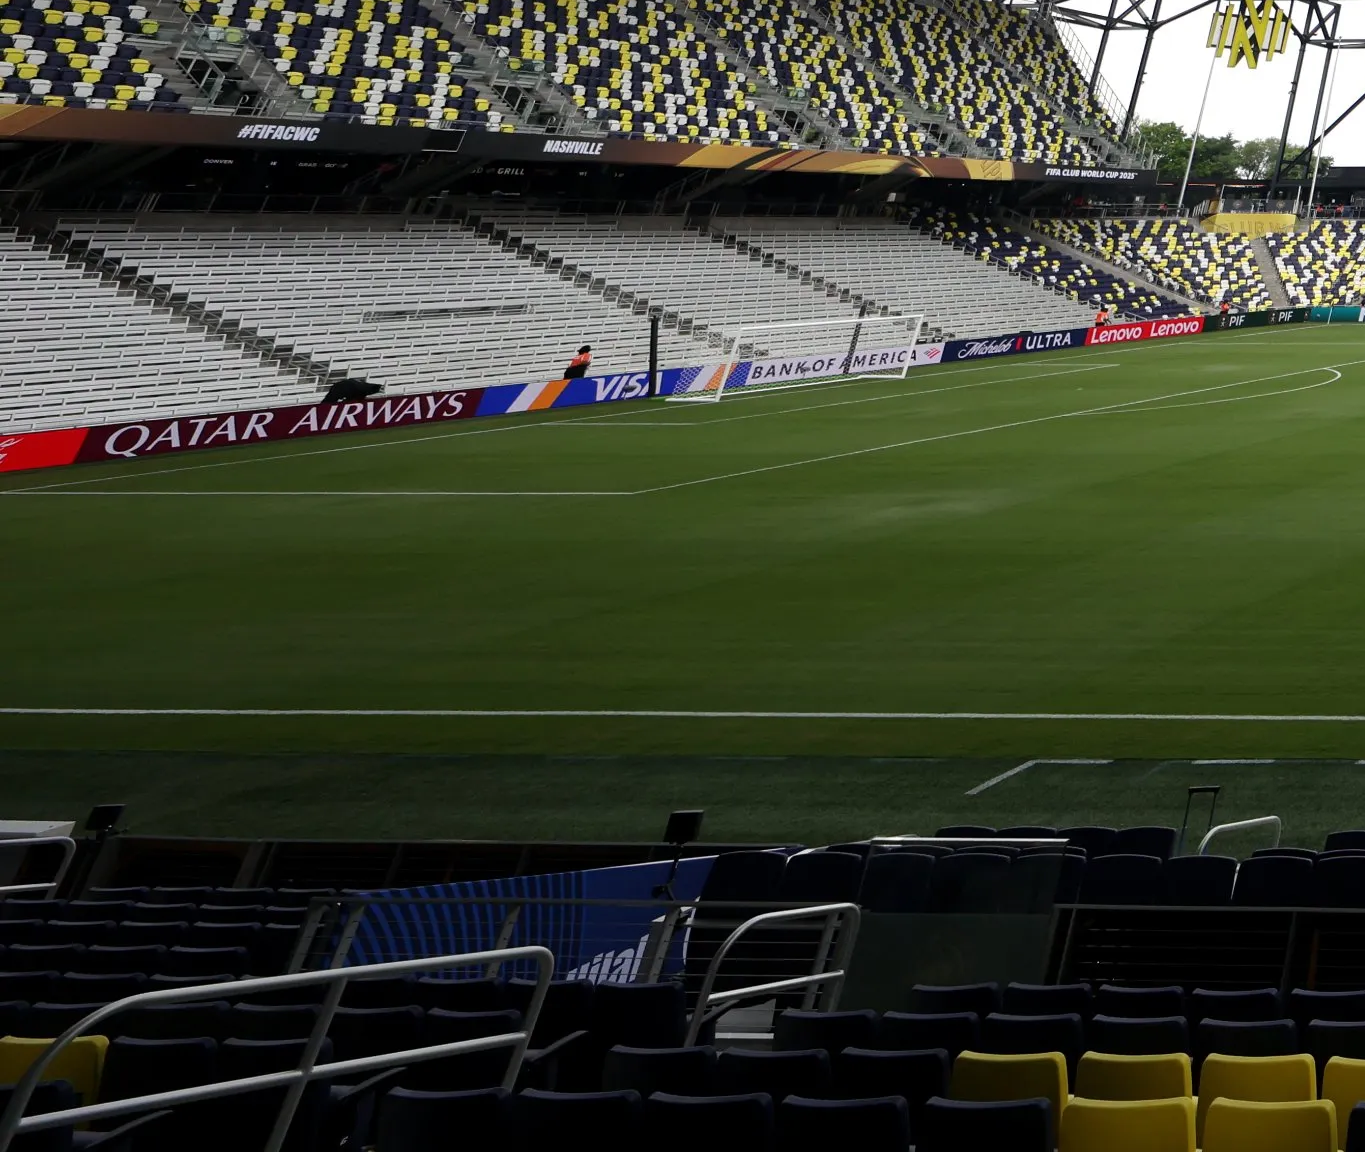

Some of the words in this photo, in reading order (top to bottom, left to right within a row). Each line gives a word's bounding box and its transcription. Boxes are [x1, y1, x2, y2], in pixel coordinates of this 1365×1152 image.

[237, 124, 320, 142] #FIFACWC
[543, 139, 604, 156] NASHVILLE
[497, 167, 525, 176] GRILL
[1045, 168, 1061, 176] FIFA
[1061, 169, 1080, 177] CLUB
[1080, 169, 1104, 178] WORLD
[1105, 170, 1119, 179] CUP
[1229, 315, 1245, 327] PIF
[1278, 311, 1293, 323] PIF
[1090, 326, 1142, 344] Lenovo
[1150, 320, 1199, 337] Lenovo
[957, 338, 1013, 359] Michelob
[1025, 332, 1071, 350] ULTRA
[751, 362, 811, 380] BANK
[811, 357, 834, 373] OF
[838, 348, 917, 372] AMERICA
[592, 370, 662, 401] VISA
[103, 411, 274, 457] QATAR
[289, 392, 467, 435] AIRWAYS
